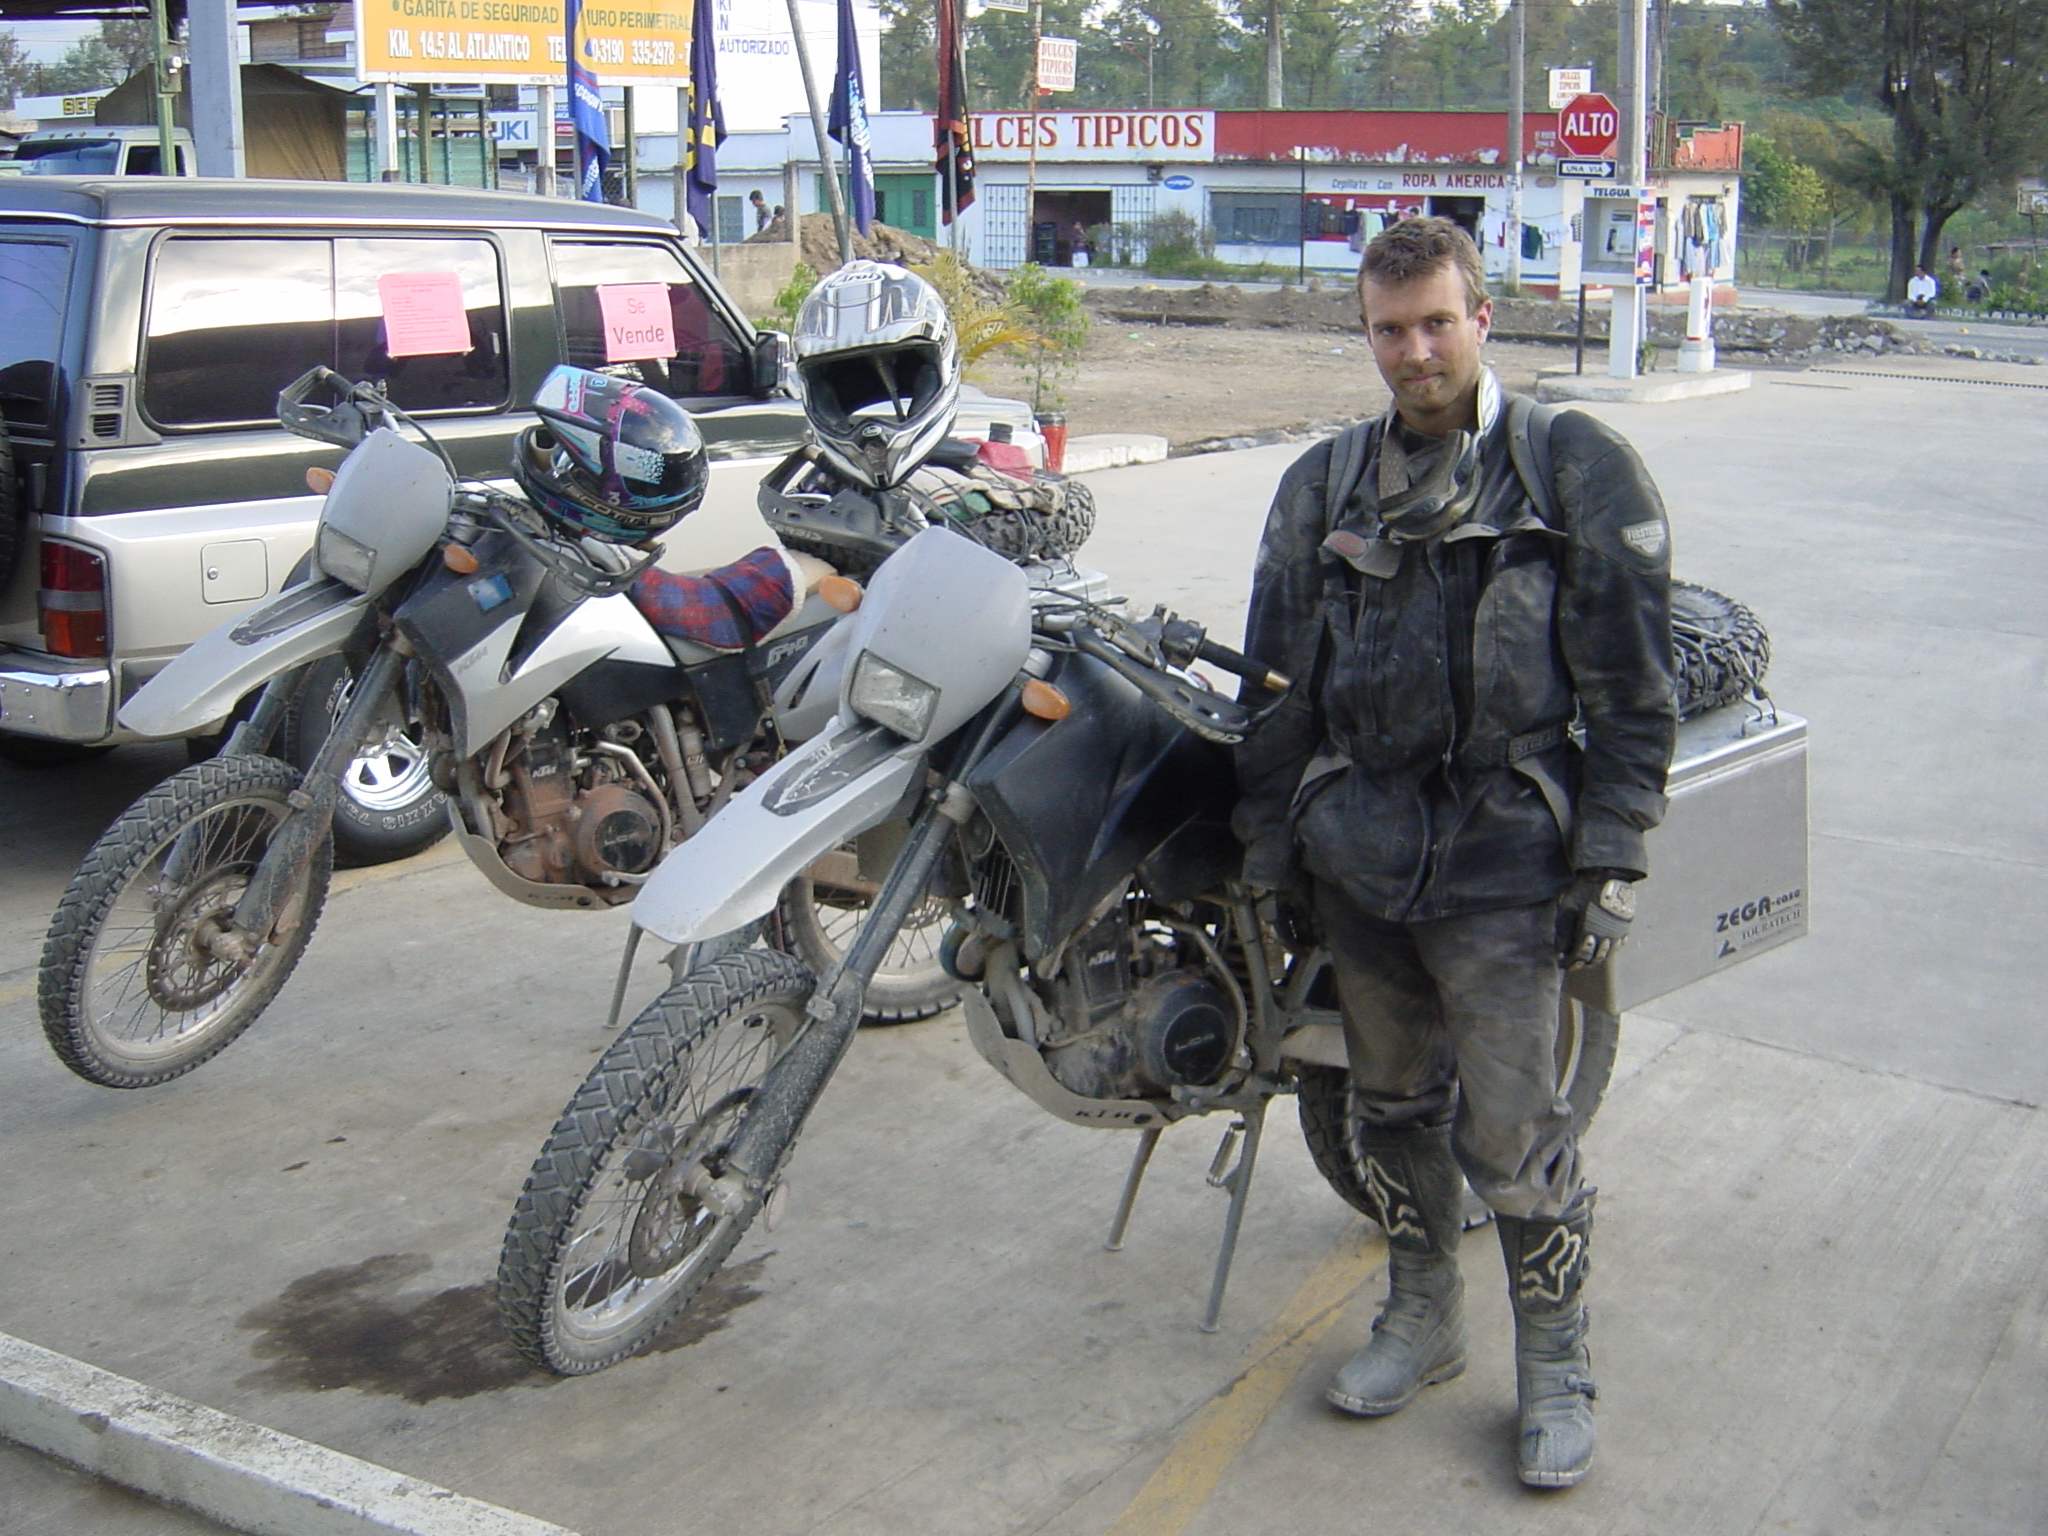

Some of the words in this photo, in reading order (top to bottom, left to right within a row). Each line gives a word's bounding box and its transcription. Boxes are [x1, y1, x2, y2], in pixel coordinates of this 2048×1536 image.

[403, 0, 456, 18] GARITA
[461, 1, 479, 20] DE
[483, 2, 559, 24] SEGURIDAD
[620, 11, 690, 30] PERIMETRAL
[448, 32, 464, 59] AL
[466, 32, 530, 61] ATLANTICO
[631, 40, 675, 66] 335-2978
[719, 38, 790, 55] AUTORIZADO
[932, 115, 1058, 149] LCES
[1072, 114, 1204, 149] TIPICOS
[1564, 112, 1614, 137] ALTO
[1589, 166, 1603, 174] VIA
[1403, 173, 1437, 188] ROPA
[1593, 187, 1630, 197] TELGUA
[627, 297, 646, 314] Se
[613, 325, 665, 345] Vende
[532, 764, 557, 778] KTM
